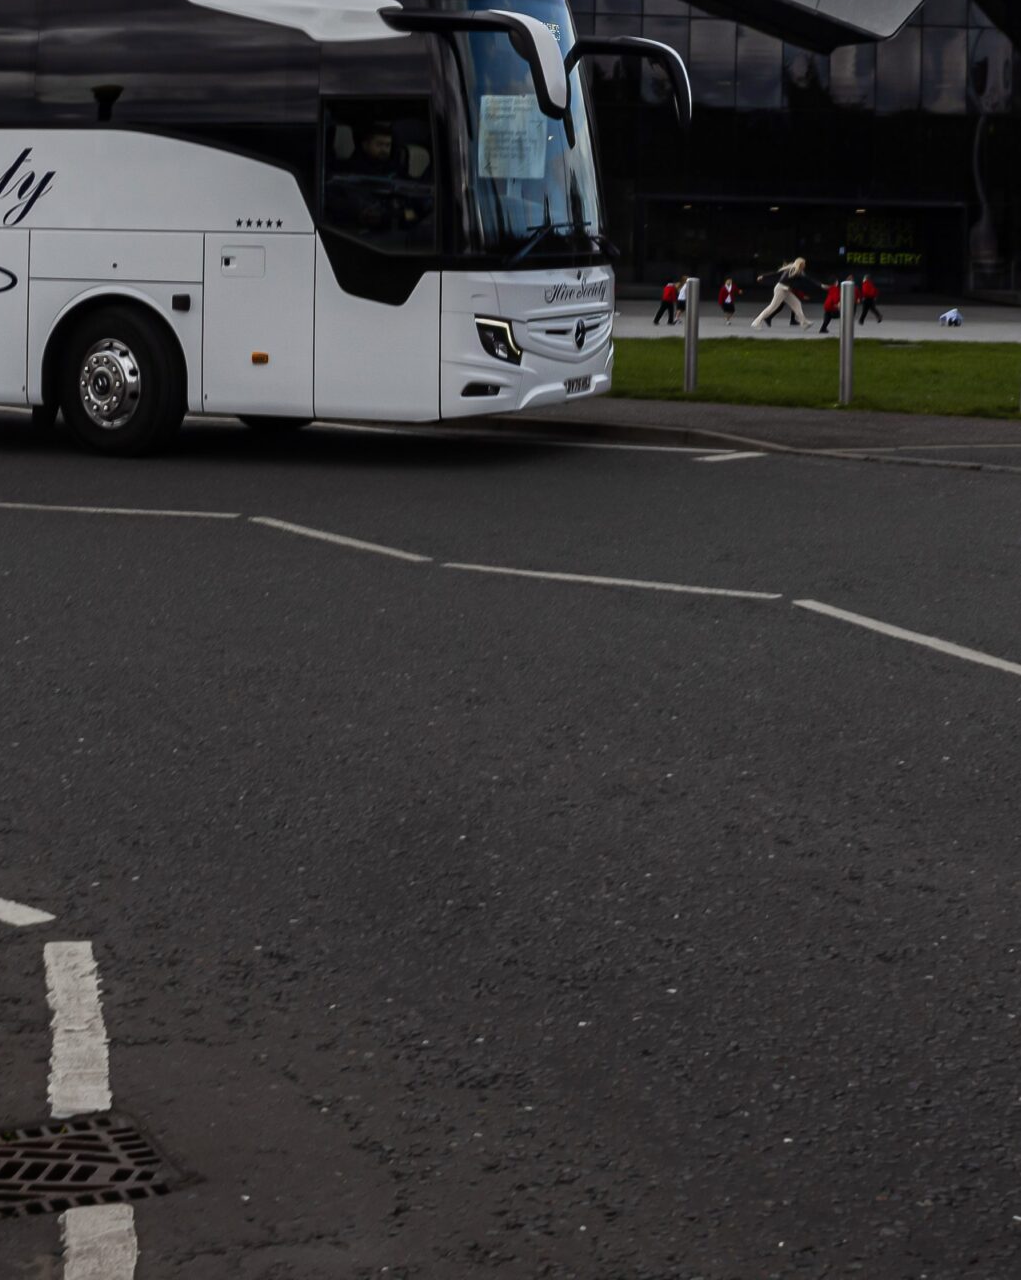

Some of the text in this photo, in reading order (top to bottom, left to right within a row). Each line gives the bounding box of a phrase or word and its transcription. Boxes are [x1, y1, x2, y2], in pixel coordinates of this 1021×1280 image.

[846, 252, 922, 265] FREE ENTRY
[545, 277, 606, 303] Hire Society
